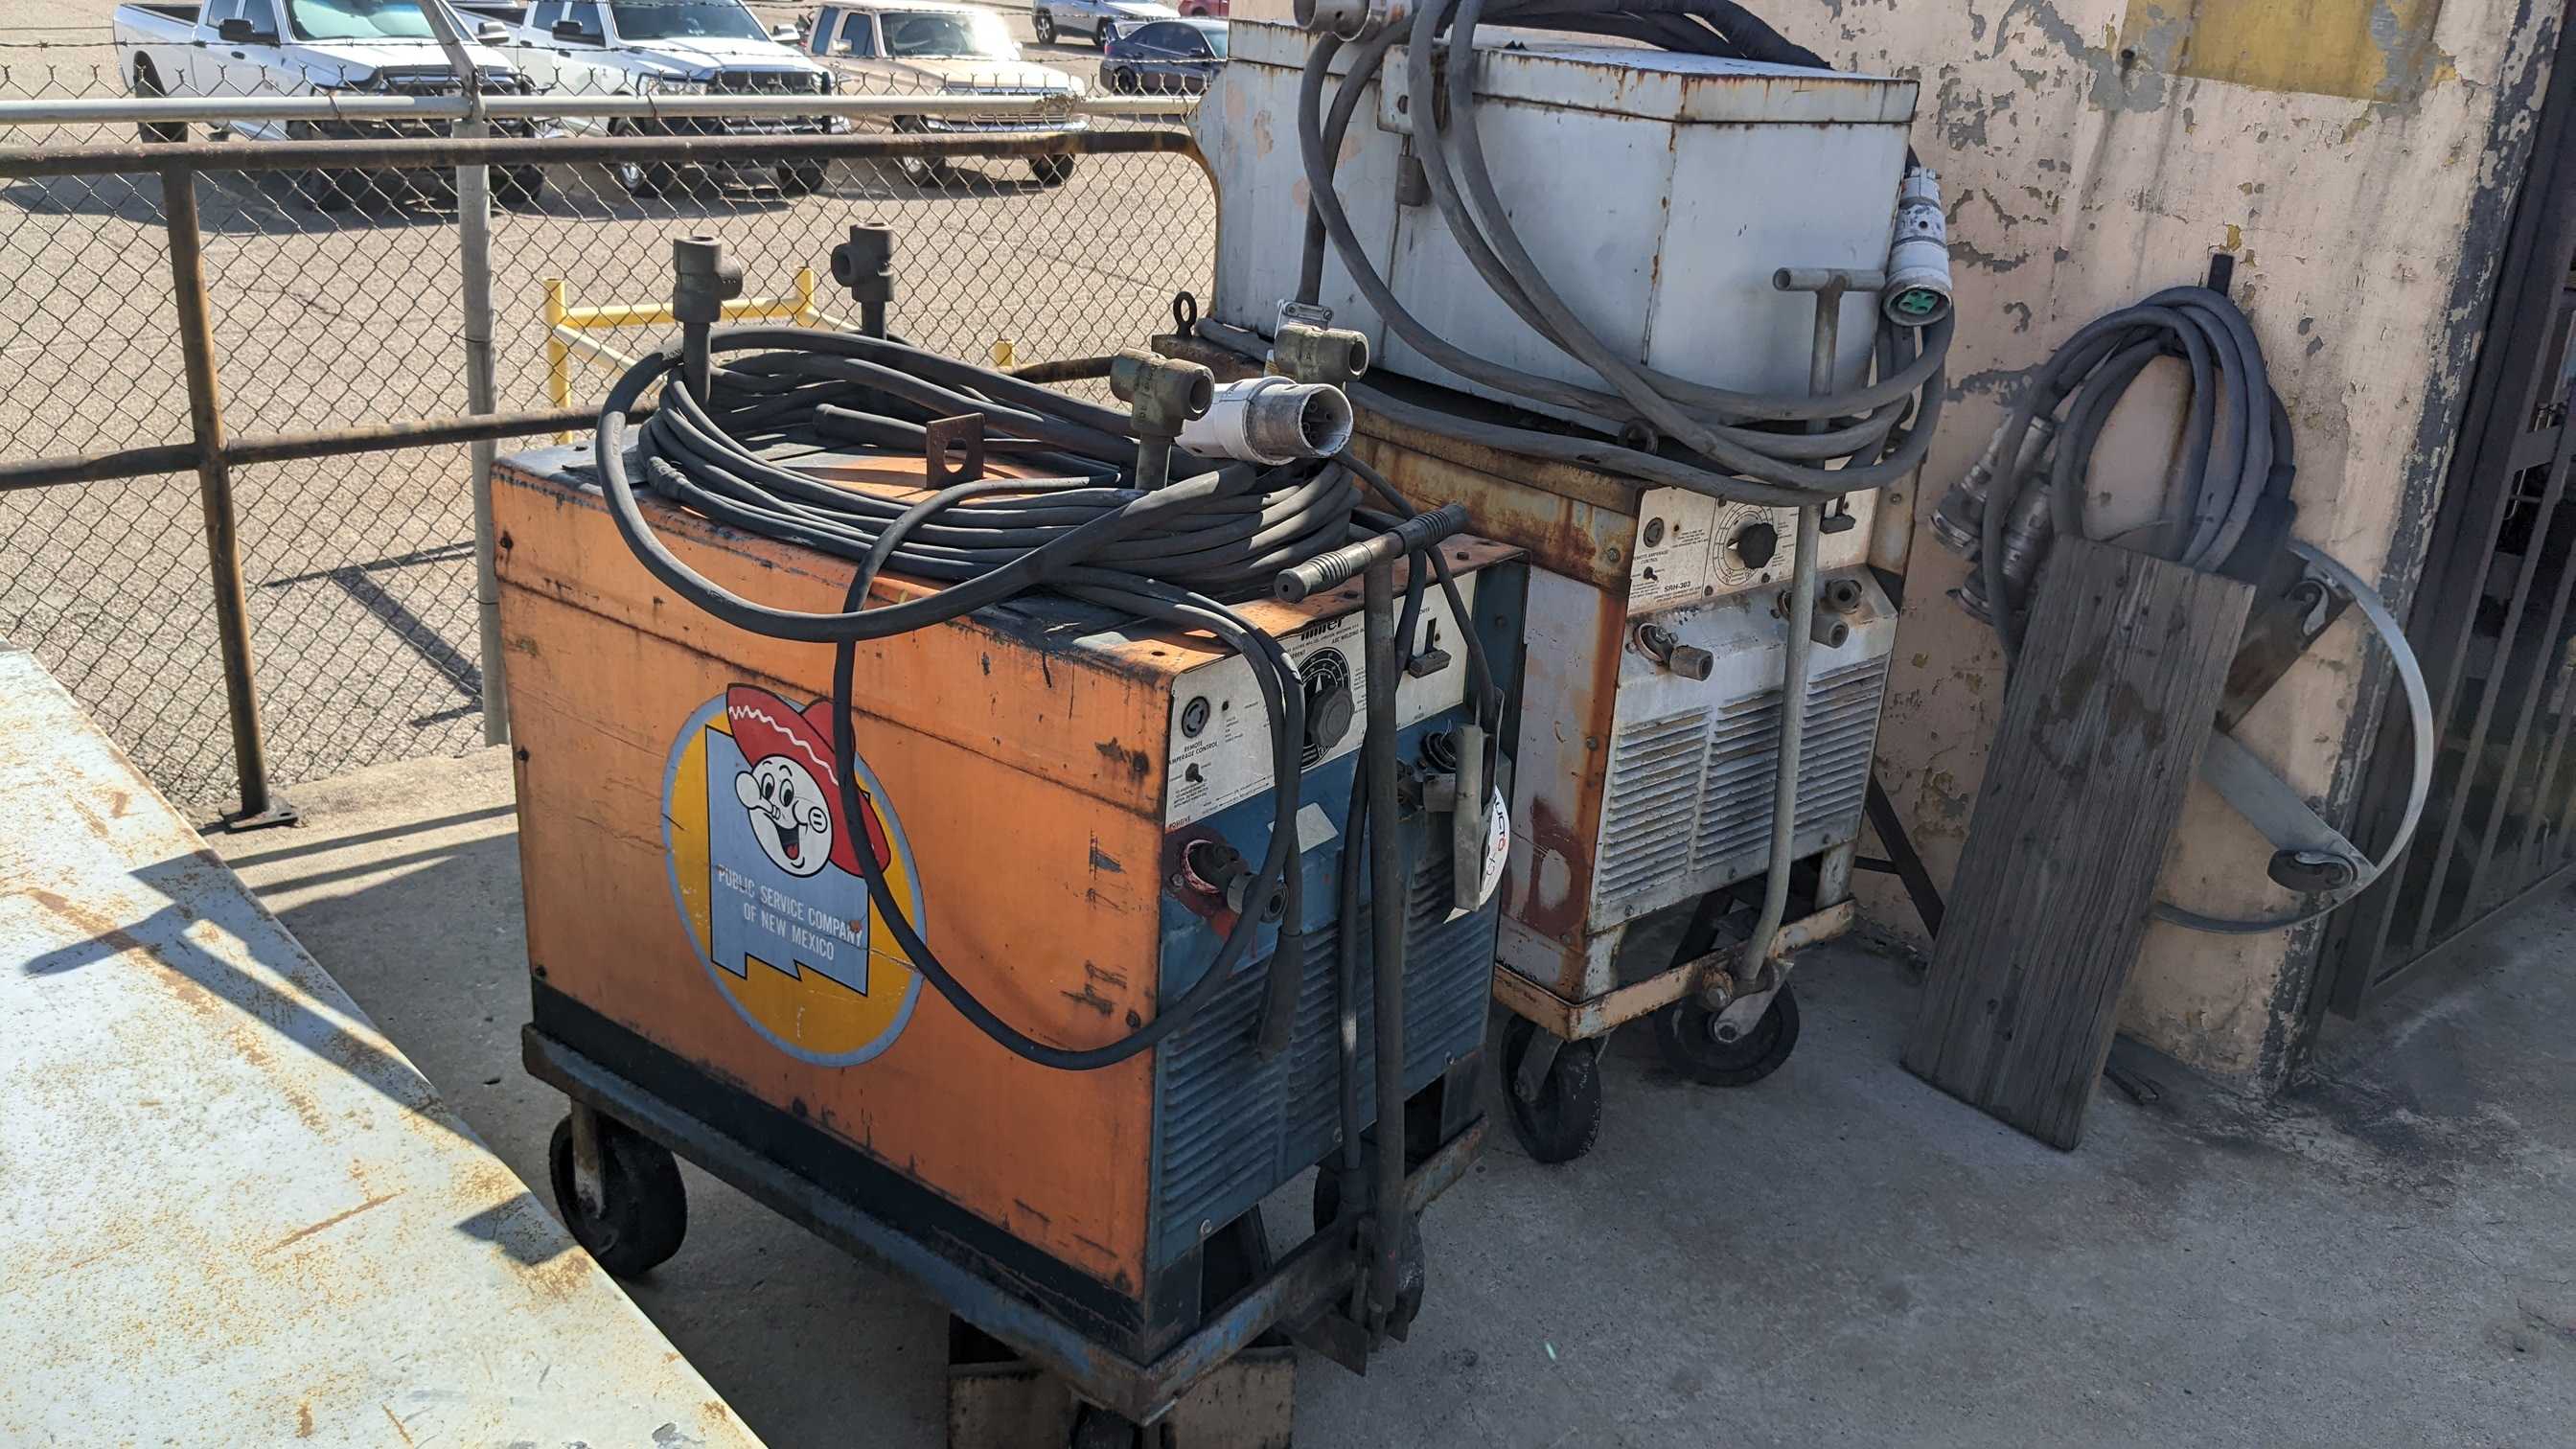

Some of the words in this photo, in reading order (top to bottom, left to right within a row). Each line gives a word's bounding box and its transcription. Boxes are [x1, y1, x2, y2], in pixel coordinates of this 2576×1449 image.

[1195, 742, 1219, 756] CONTROL
[718, 864, 755, 898] PUBLIC
[760, 886, 805, 921] SERVICE
[808, 908, 862, 947] COMPANY
[744, 903, 757, 923] OF
[761, 911, 787, 937] NEW
[792, 926, 835, 961] MEXICO
